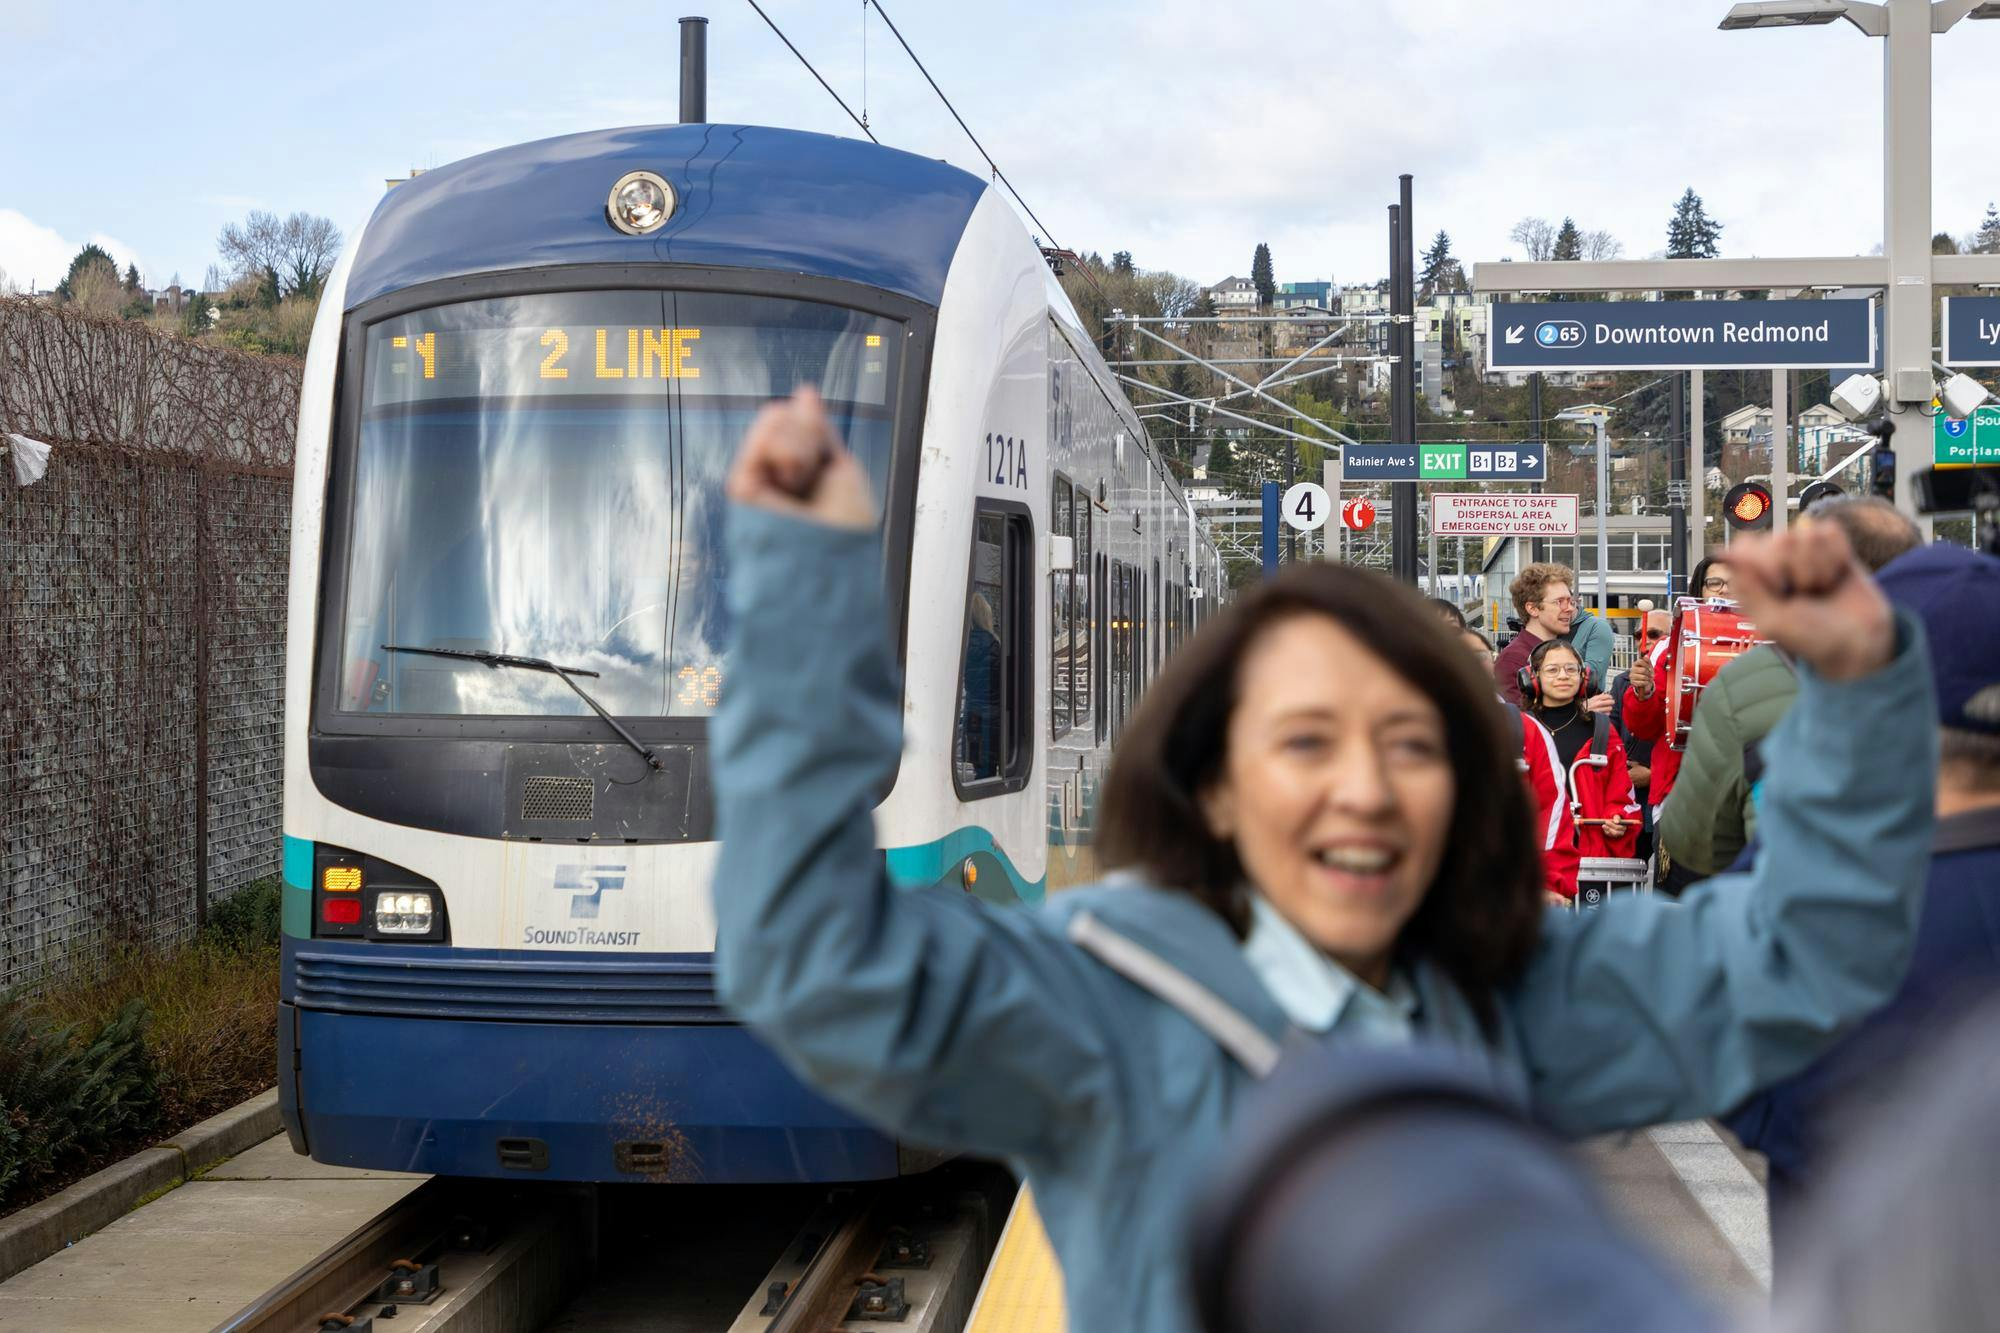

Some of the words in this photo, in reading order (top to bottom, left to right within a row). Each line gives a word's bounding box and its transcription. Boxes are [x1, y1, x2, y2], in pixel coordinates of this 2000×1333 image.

[1544, 327, 1553, 341] 2
[1560, 327, 1580, 341] 65
[1595, 322, 1714, 344] Downtown
[1723, 320, 1829, 343] Redmond
[540, 329, 568, 378] 2
[595, 329, 700, 378] LINE
[1952, 422, 1960, 433] 5
[986, 432, 1028, 490] 121A
[1349, 456, 1384, 467] Rainier
[1387, 456, 1405, 467] Ave
[1408, 456, 1415, 467] S
[1424, 453, 1462, 470] EXIT
[1473, 455, 1489, 469] B1
[1498, 455, 1515, 469] B2
[1295, 491, 1316, 522] 4
[1452, 498, 1510, 507] ENTRANCE
[1513, 499, 1527, 507] TO
[1530, 499, 1558, 508] SAFE
[1457, 510, 1519, 519] DISPERSAL
[1521, 510, 1552, 519] AREA
[1441, 522, 1510, 531] EMERGENCY
[1513, 522, 1535, 531] USE
[1538, 522, 1568, 532] ONLY
